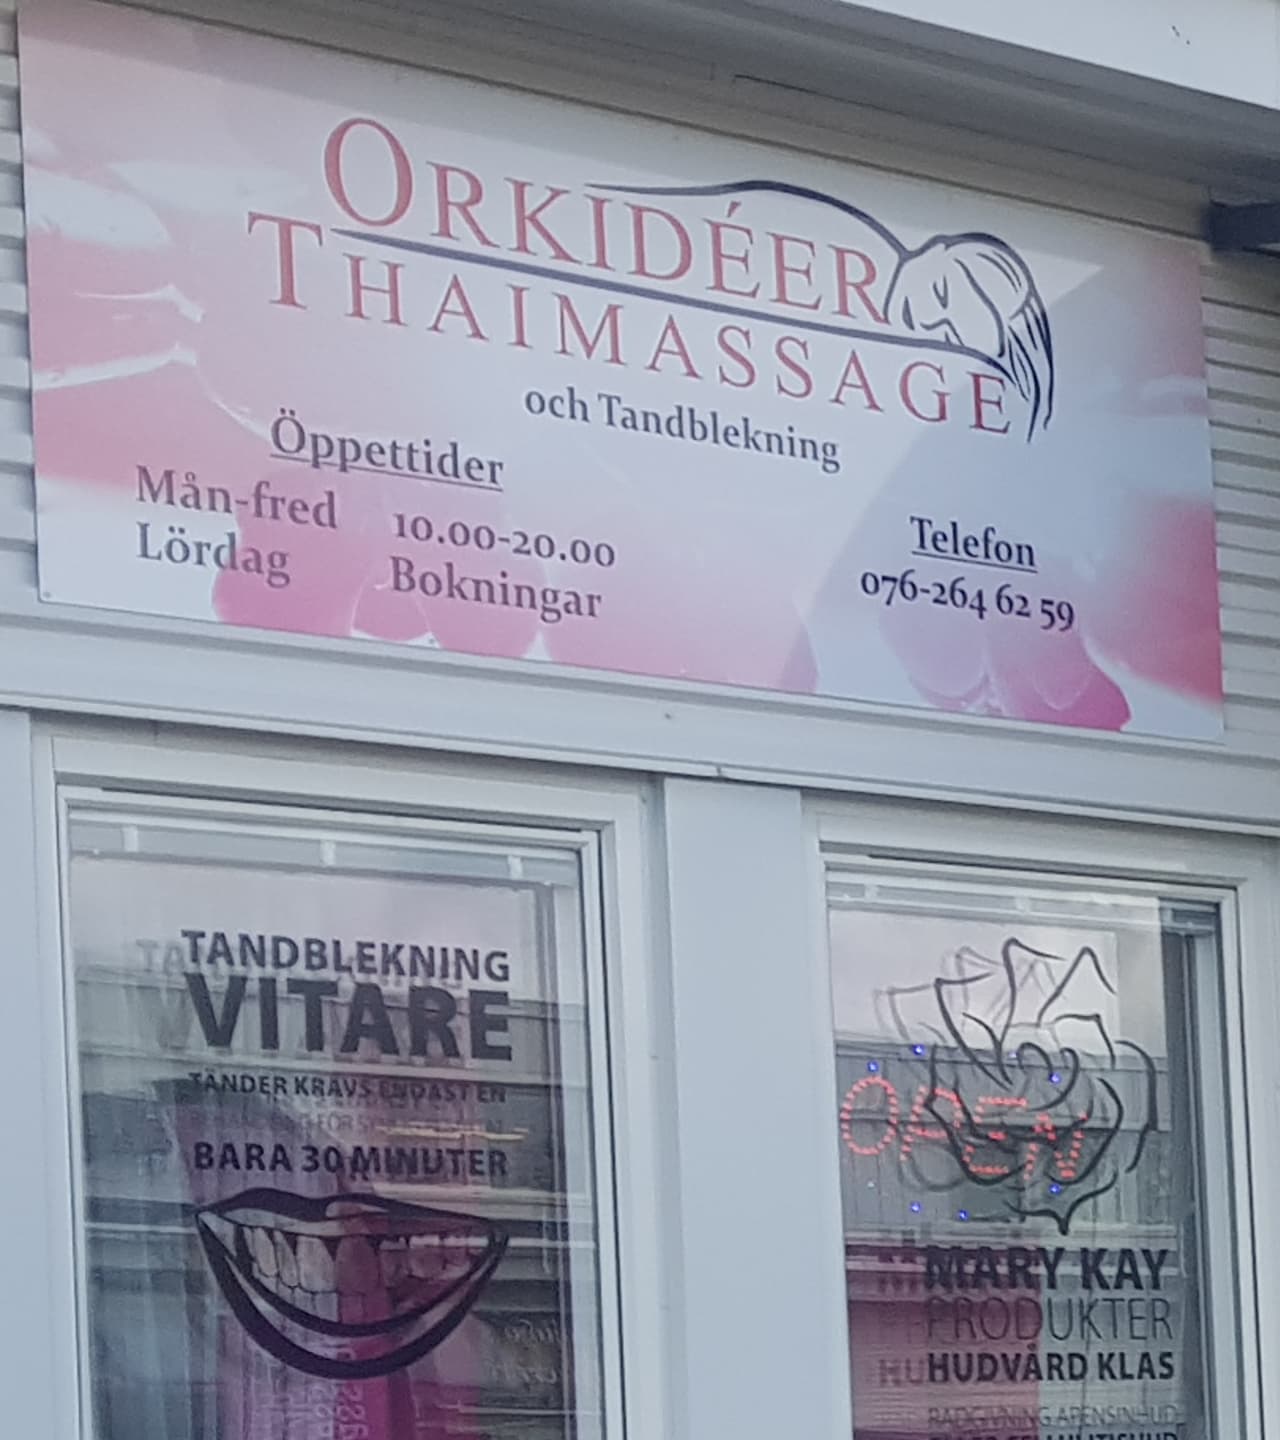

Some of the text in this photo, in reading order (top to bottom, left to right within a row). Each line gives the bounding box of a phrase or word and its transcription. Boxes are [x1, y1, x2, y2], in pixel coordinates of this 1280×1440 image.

[323, 116, 892, 325] ORKIDÉER
[248, 211, 1011, 435] THAIMASSAGE
[269, 407, 504, 487] Öppettider
[525, 386, 841, 474] och Tandblekning
[135, 464, 616, 569] Mån-fred 10.00-20.00
[909, 514, 1037, 568] Telefon
[136, 521, 603, 624] Lördag Bokningar
[861, 568, 1076, 632] 076-264 62 59
[181, 928, 511, 982] TANDBLEKNING
[182, 971, 513, 1062] VITARE
[193, 1141, 509, 1178] BARA 30 MINUTER
[839, 1075, 1090, 1181] OPEN
[924, 1245, 1169, 1291] MARY KAY
[927, 1297, 1174, 1342] PRODUKTER
[928, 1342, 1175, 1384] HUDVÅRD KLAS
